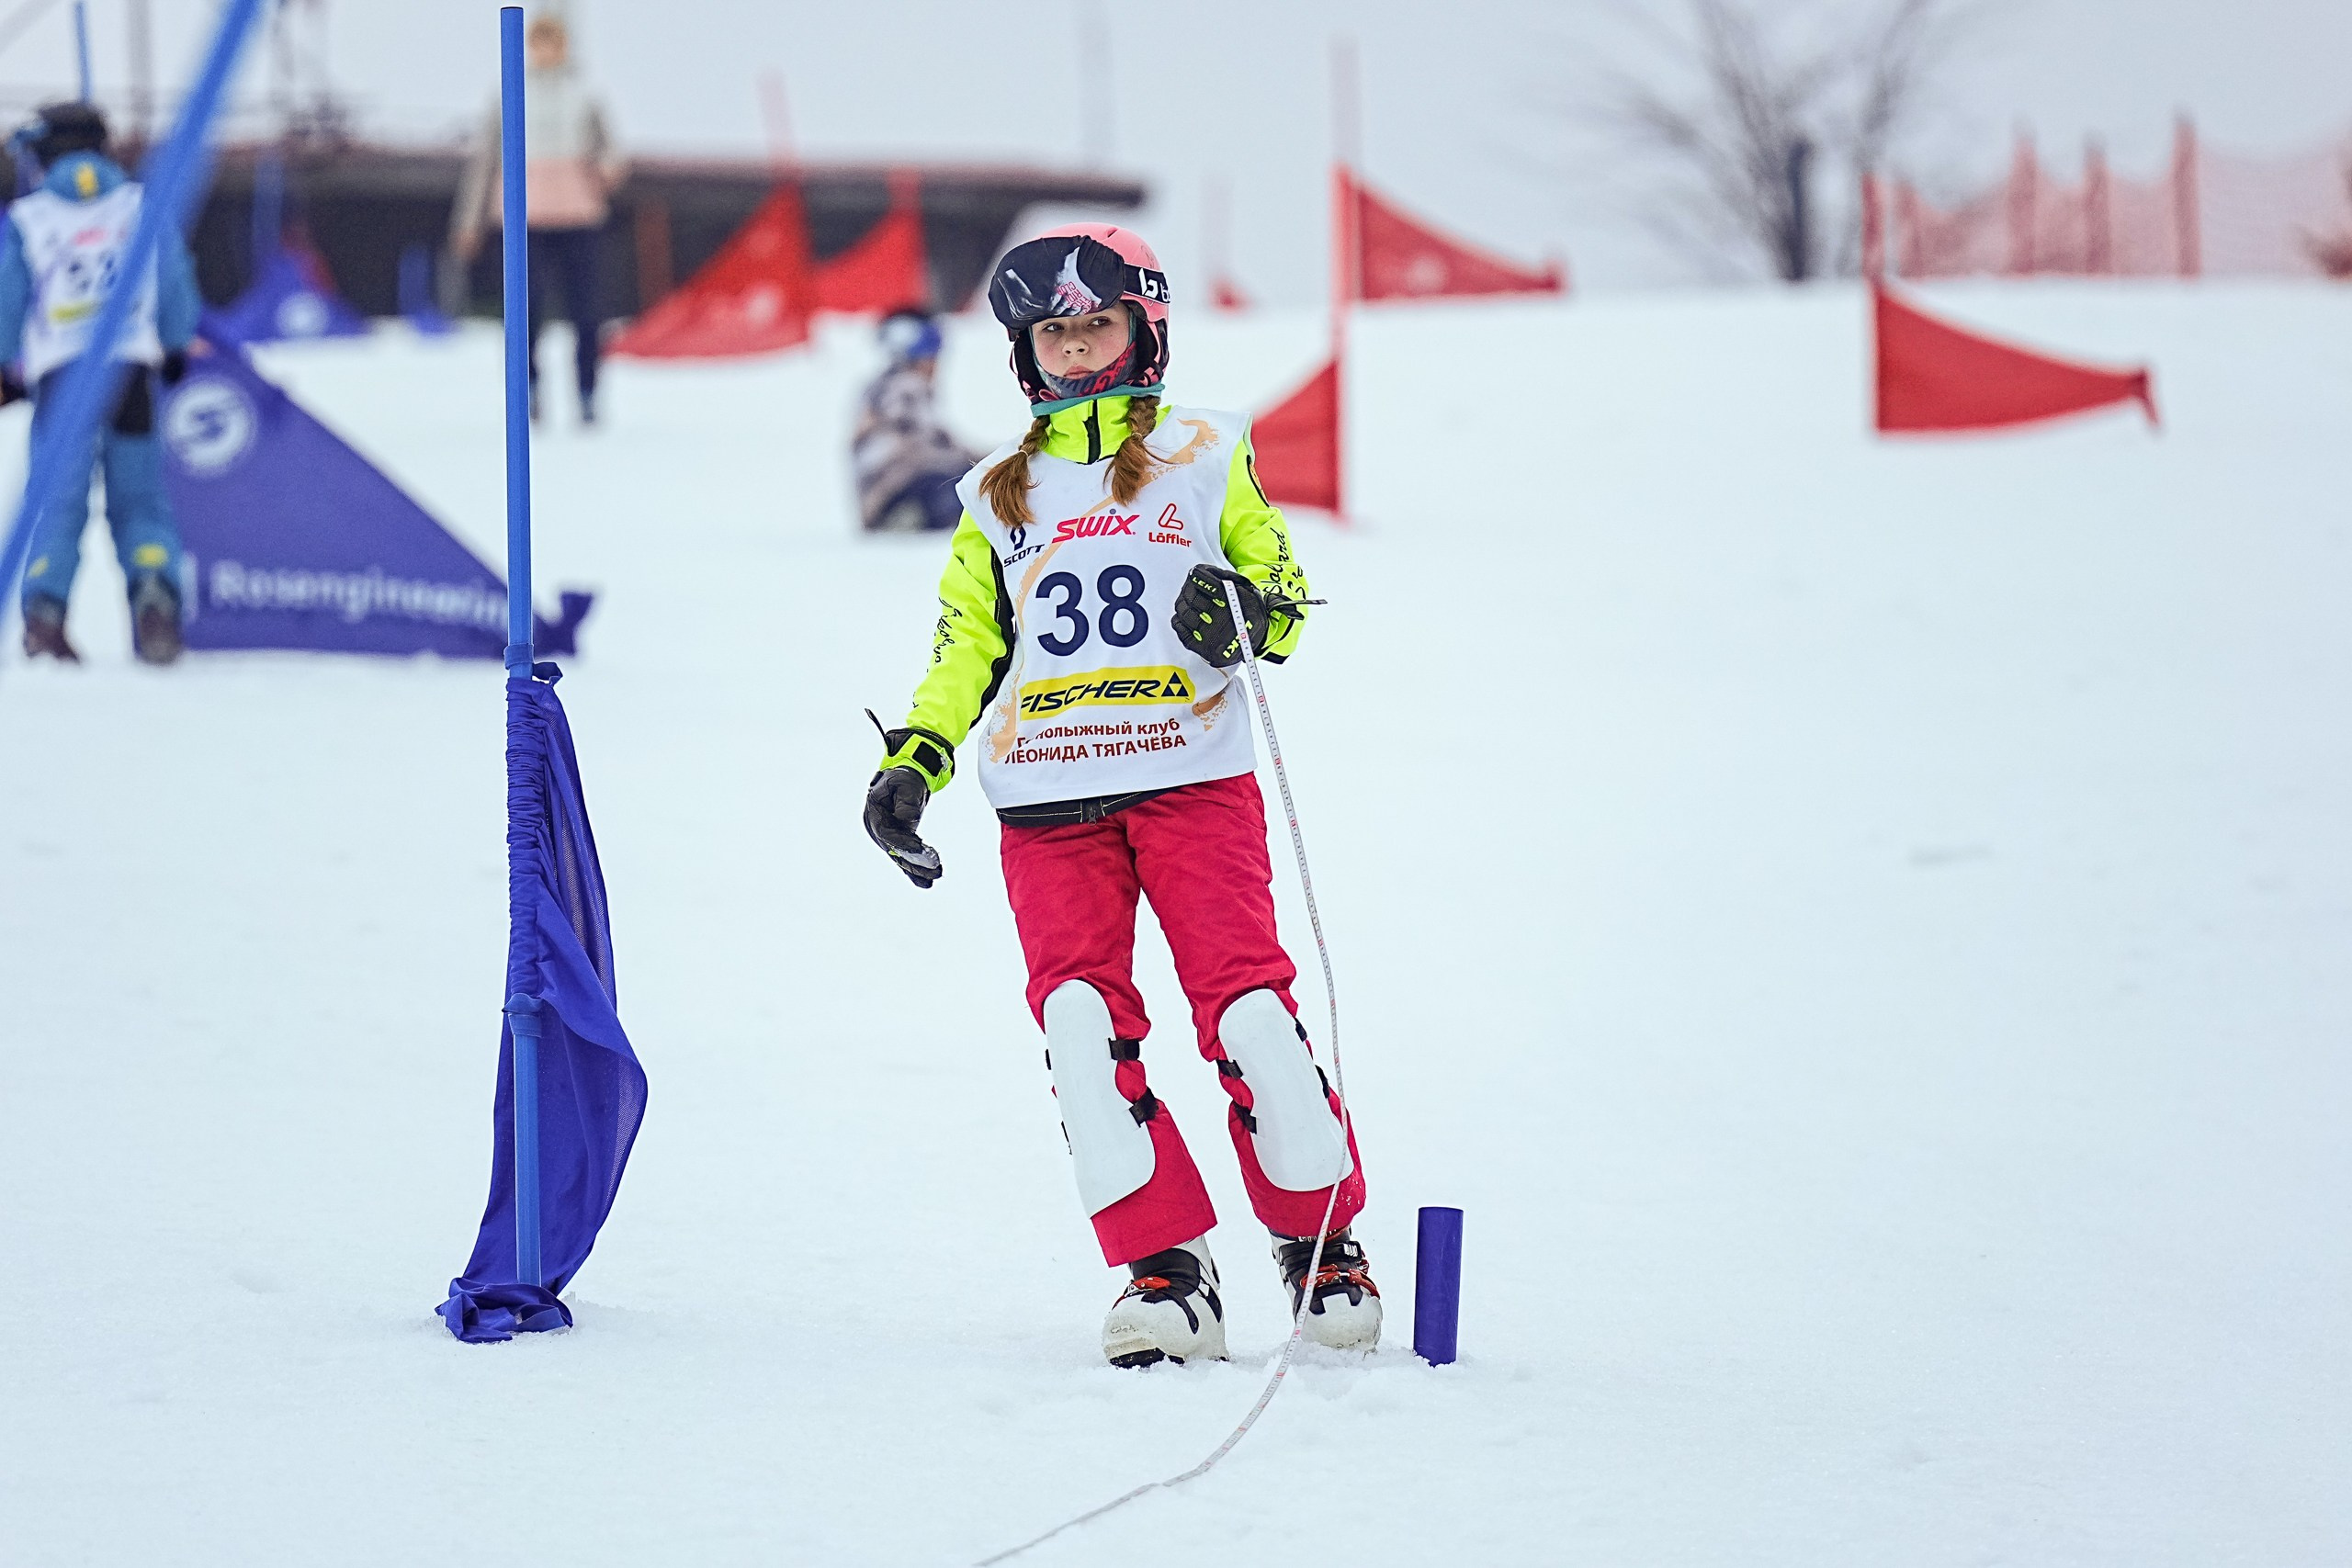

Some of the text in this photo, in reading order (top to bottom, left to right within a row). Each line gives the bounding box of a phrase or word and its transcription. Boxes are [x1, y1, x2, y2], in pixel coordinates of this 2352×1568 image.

[1148, 532, 1193, 547] Löffler
[1004, 544, 1045, 568] SCOTT
[1192, 577, 1217, 592] LEKI
[1035, 564, 1149, 656] 38
[1222, 620, 1253, 659] LKI
[1021, 680, 1161, 713] FISCHER
[1136, 717, 1181, 736] клуб
[1004, 734, 1187, 764] ЛЕОНИДА ТЯГАЧЁВА
